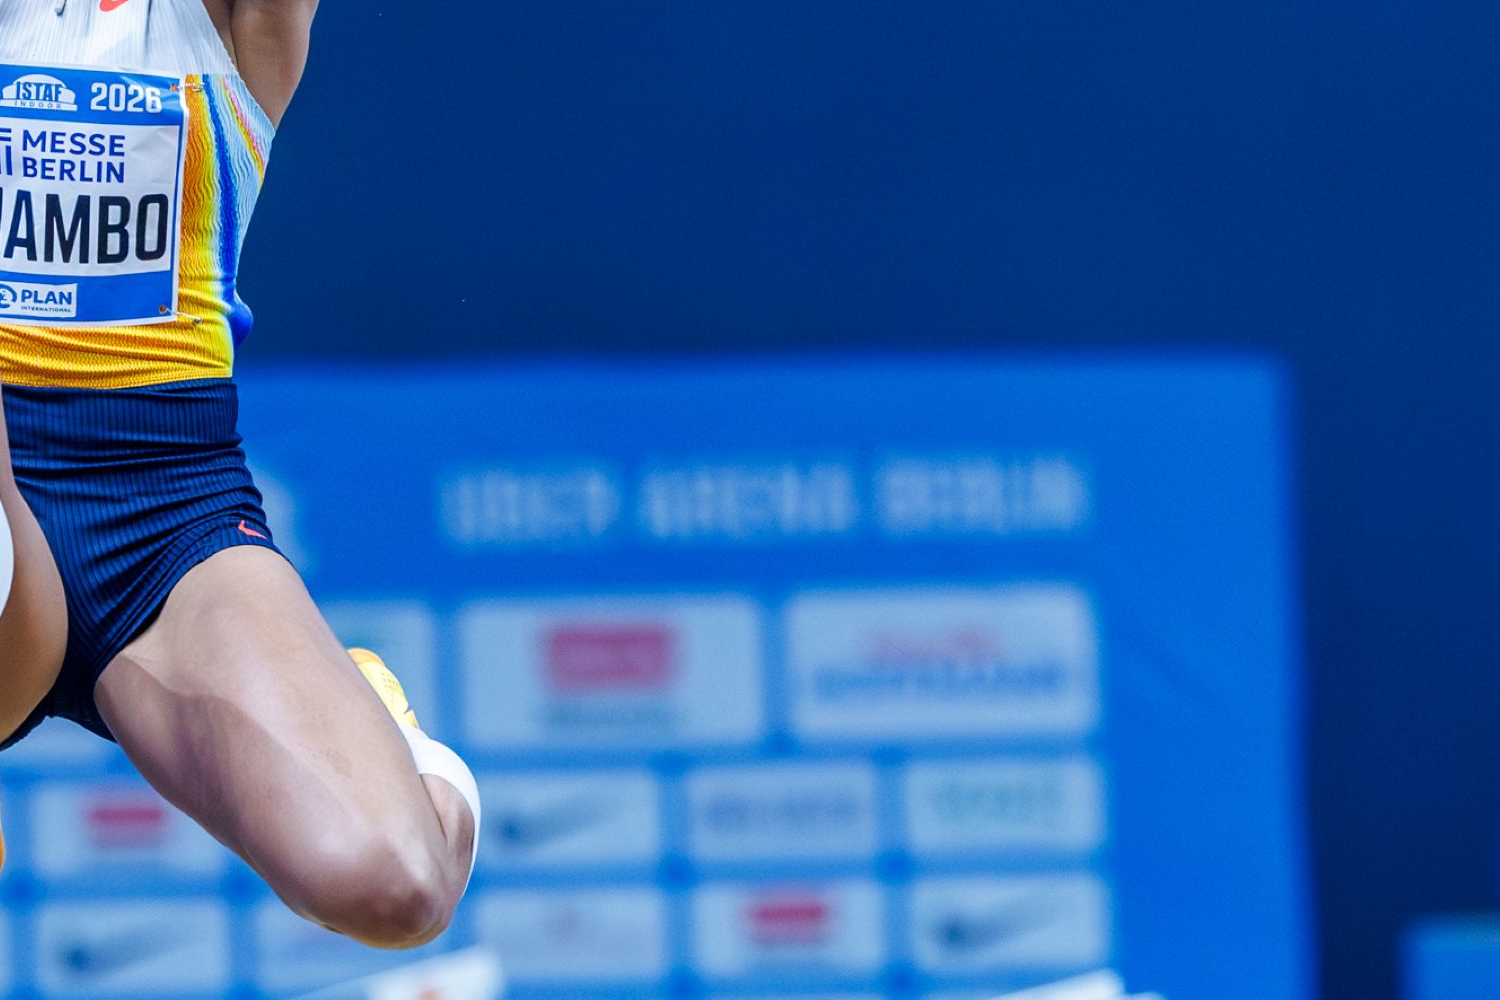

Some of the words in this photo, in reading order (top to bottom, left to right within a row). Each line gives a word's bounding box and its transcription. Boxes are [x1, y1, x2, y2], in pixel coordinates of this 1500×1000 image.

[13, 100, 62, 109] INDOOR
[16, 81, 62, 101] ISTAF
[90, 82, 162, 113] 2026
[21, 130, 126, 157] MESSE
[22, 157, 125, 183] BERLIN
[21, 289, 72, 305] PLAN
[21, 305, 71, 313] INTERNATIONAL
